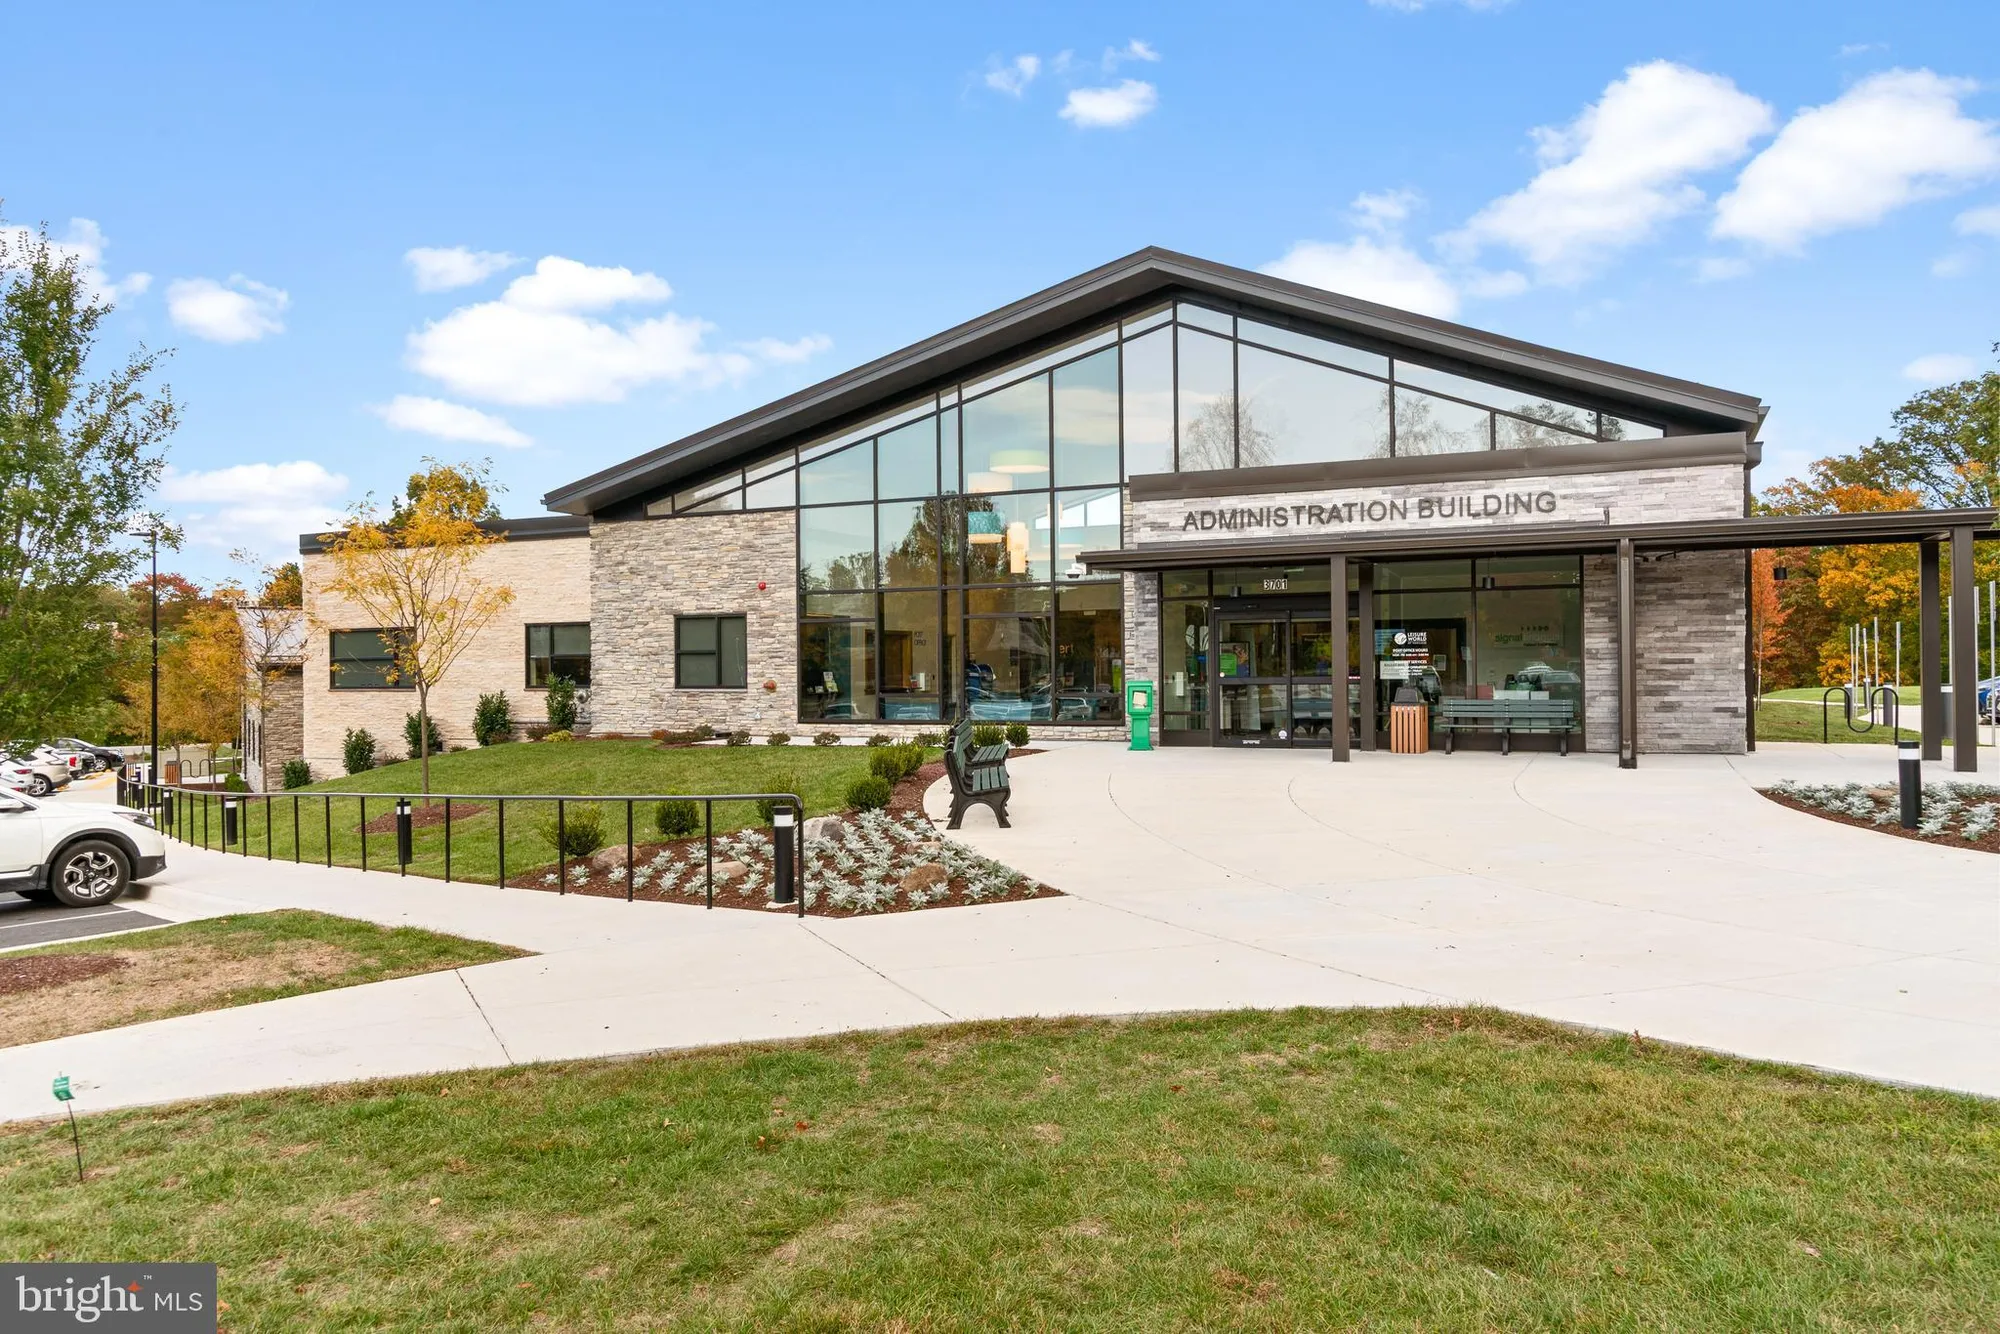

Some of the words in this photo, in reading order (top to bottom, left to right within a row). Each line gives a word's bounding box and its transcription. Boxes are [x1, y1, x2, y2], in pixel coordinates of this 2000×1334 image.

[1182, 500, 1407, 532] ADMINISTRATION
[1418, 491, 1557, 519] BUILDING
[1263, 579, 1288, 590] 3701
